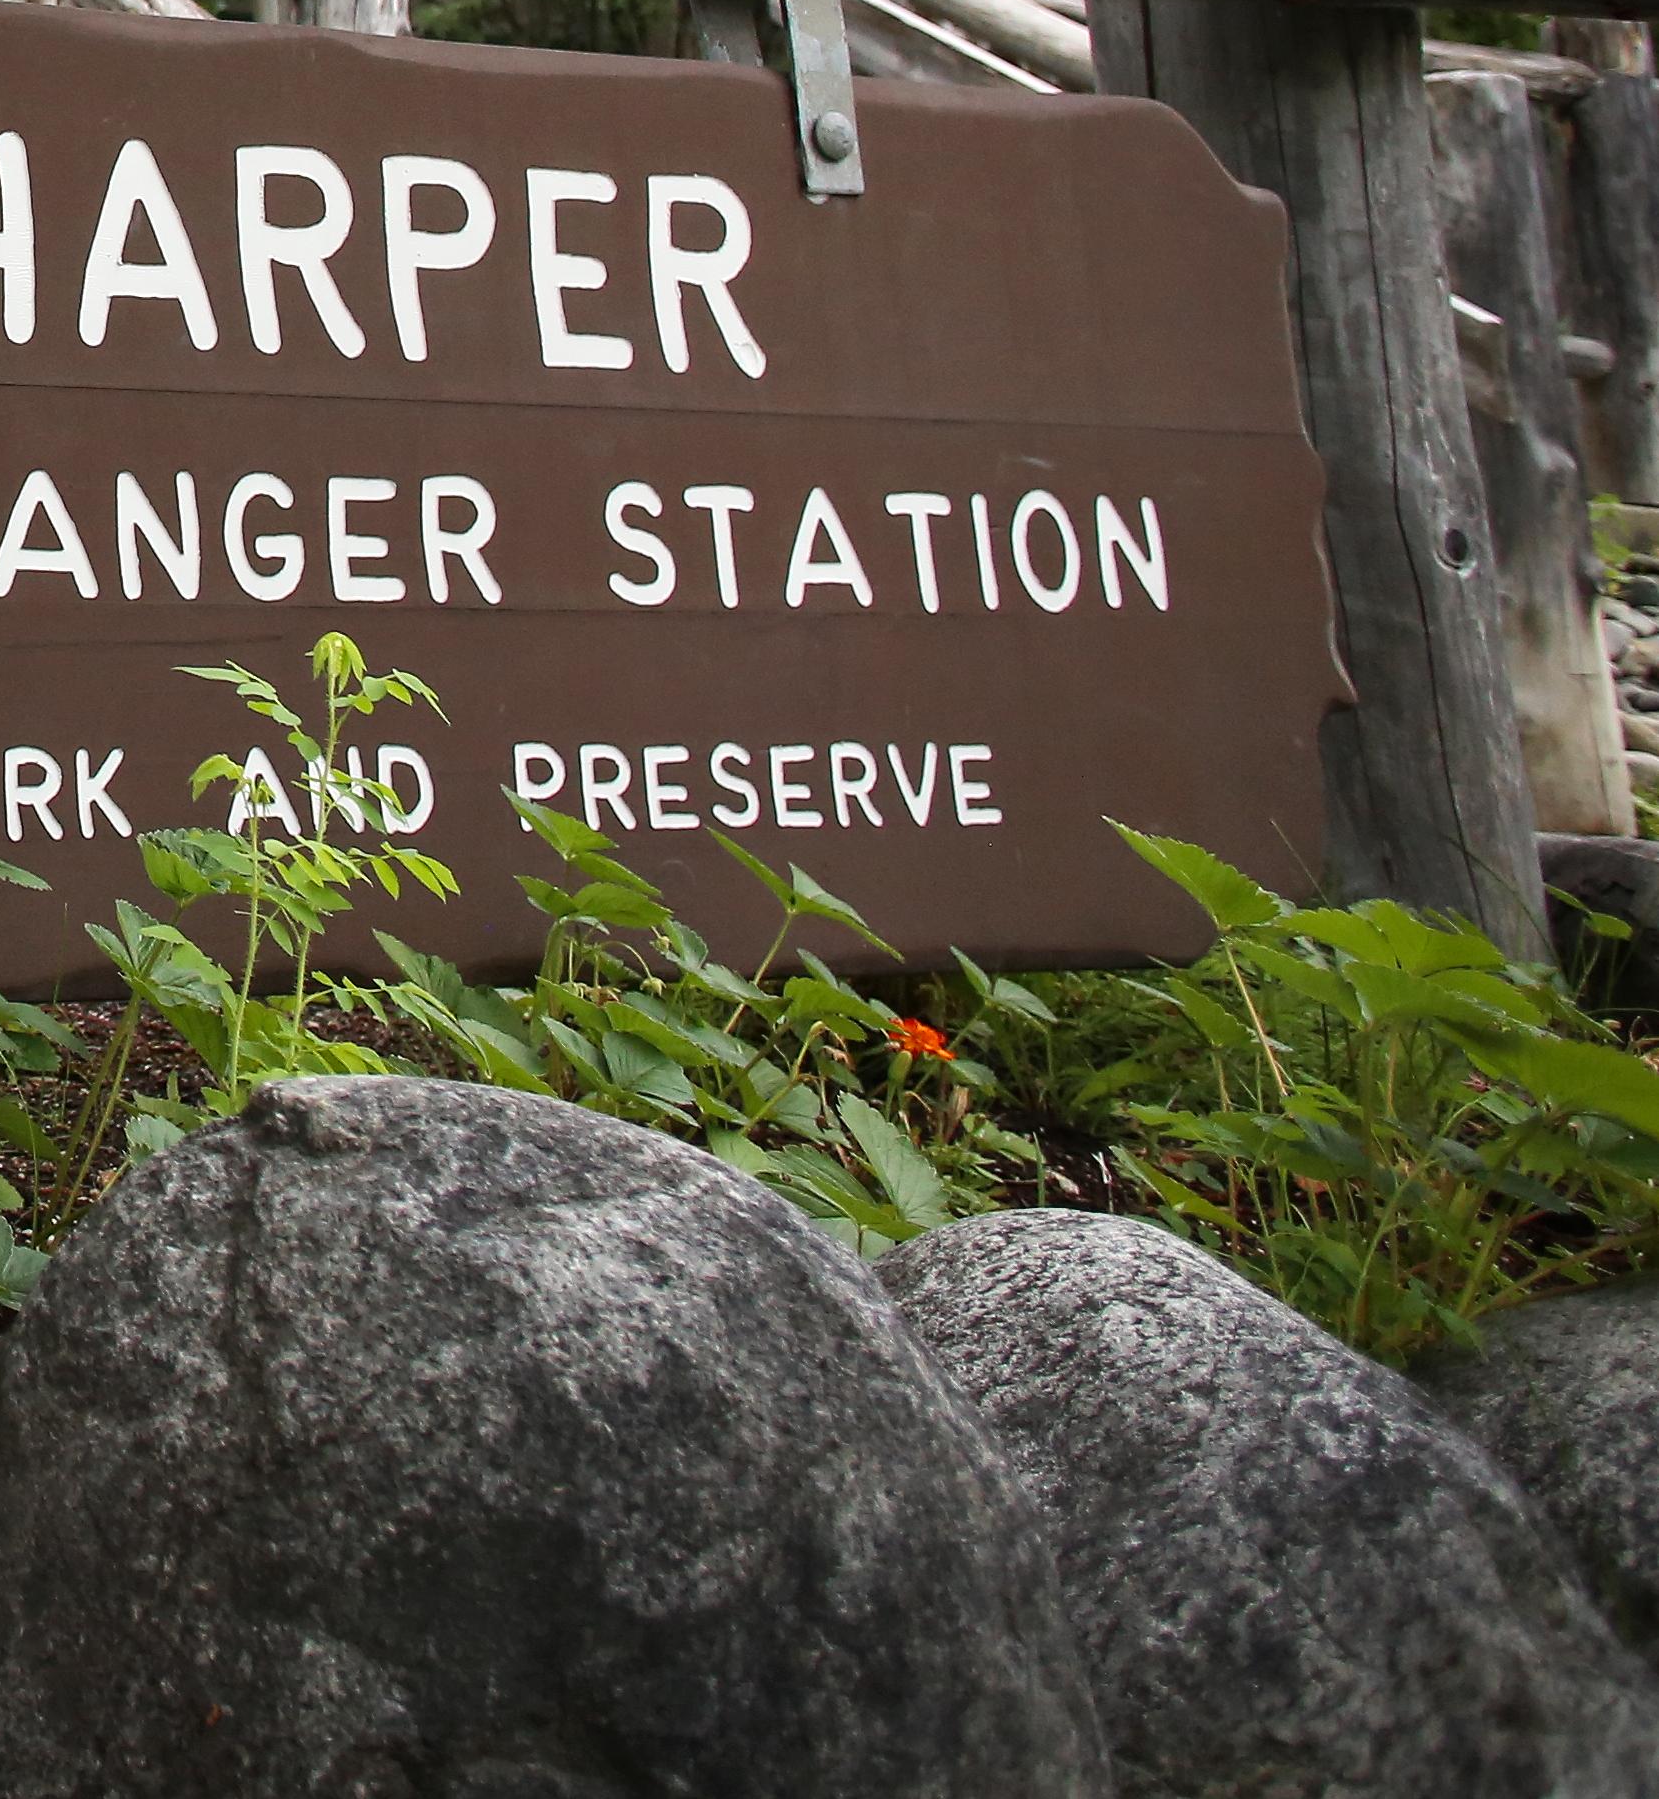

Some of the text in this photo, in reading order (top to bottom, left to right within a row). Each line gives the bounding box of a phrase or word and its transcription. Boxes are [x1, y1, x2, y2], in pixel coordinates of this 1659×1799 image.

[604, 480, 1170, 615] STATION
[226, 743, 436, 838] AND
[513, 740, 1004, 834] PRESERVE
